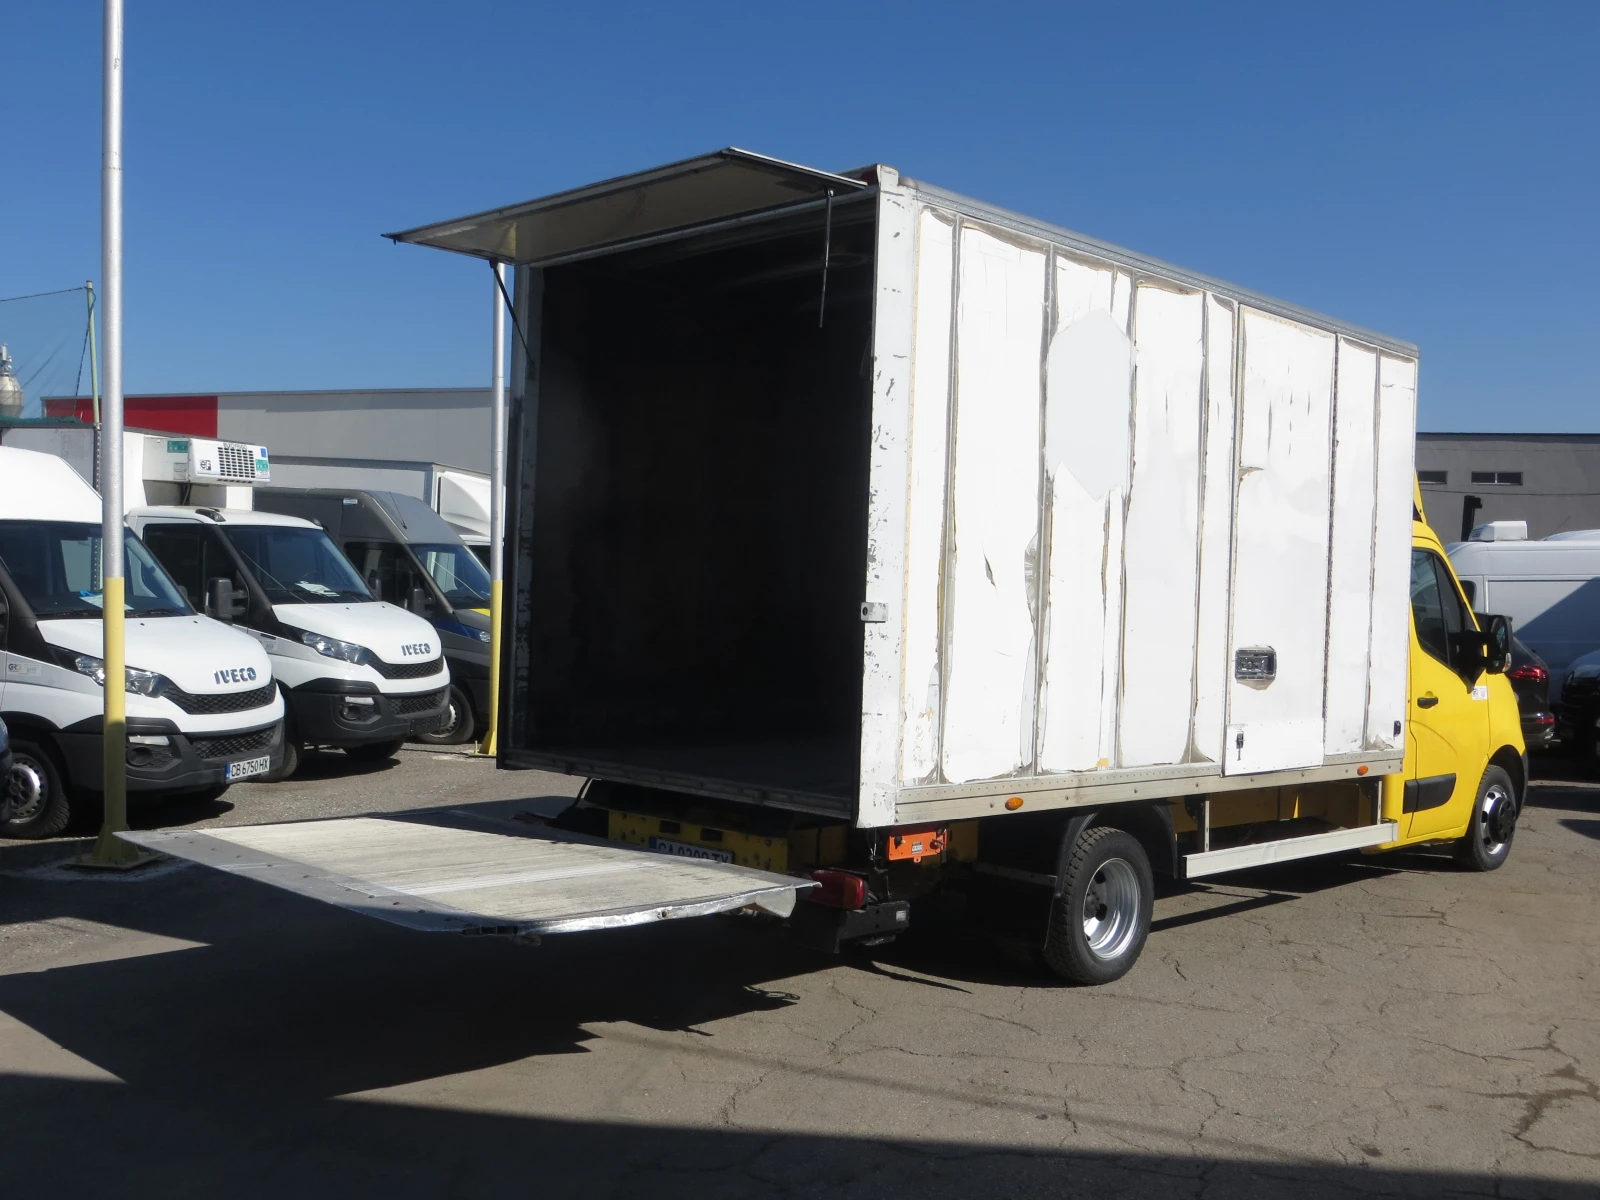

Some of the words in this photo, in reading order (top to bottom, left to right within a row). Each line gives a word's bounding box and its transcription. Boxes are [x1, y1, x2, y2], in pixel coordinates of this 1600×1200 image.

[401, 642, 431, 656] IVECO
[213, 667, 256, 685] IVECO
[231, 763, 241, 777] CB
[242, 760, 259, 775] 6750
[260, 757, 269, 771] HX
